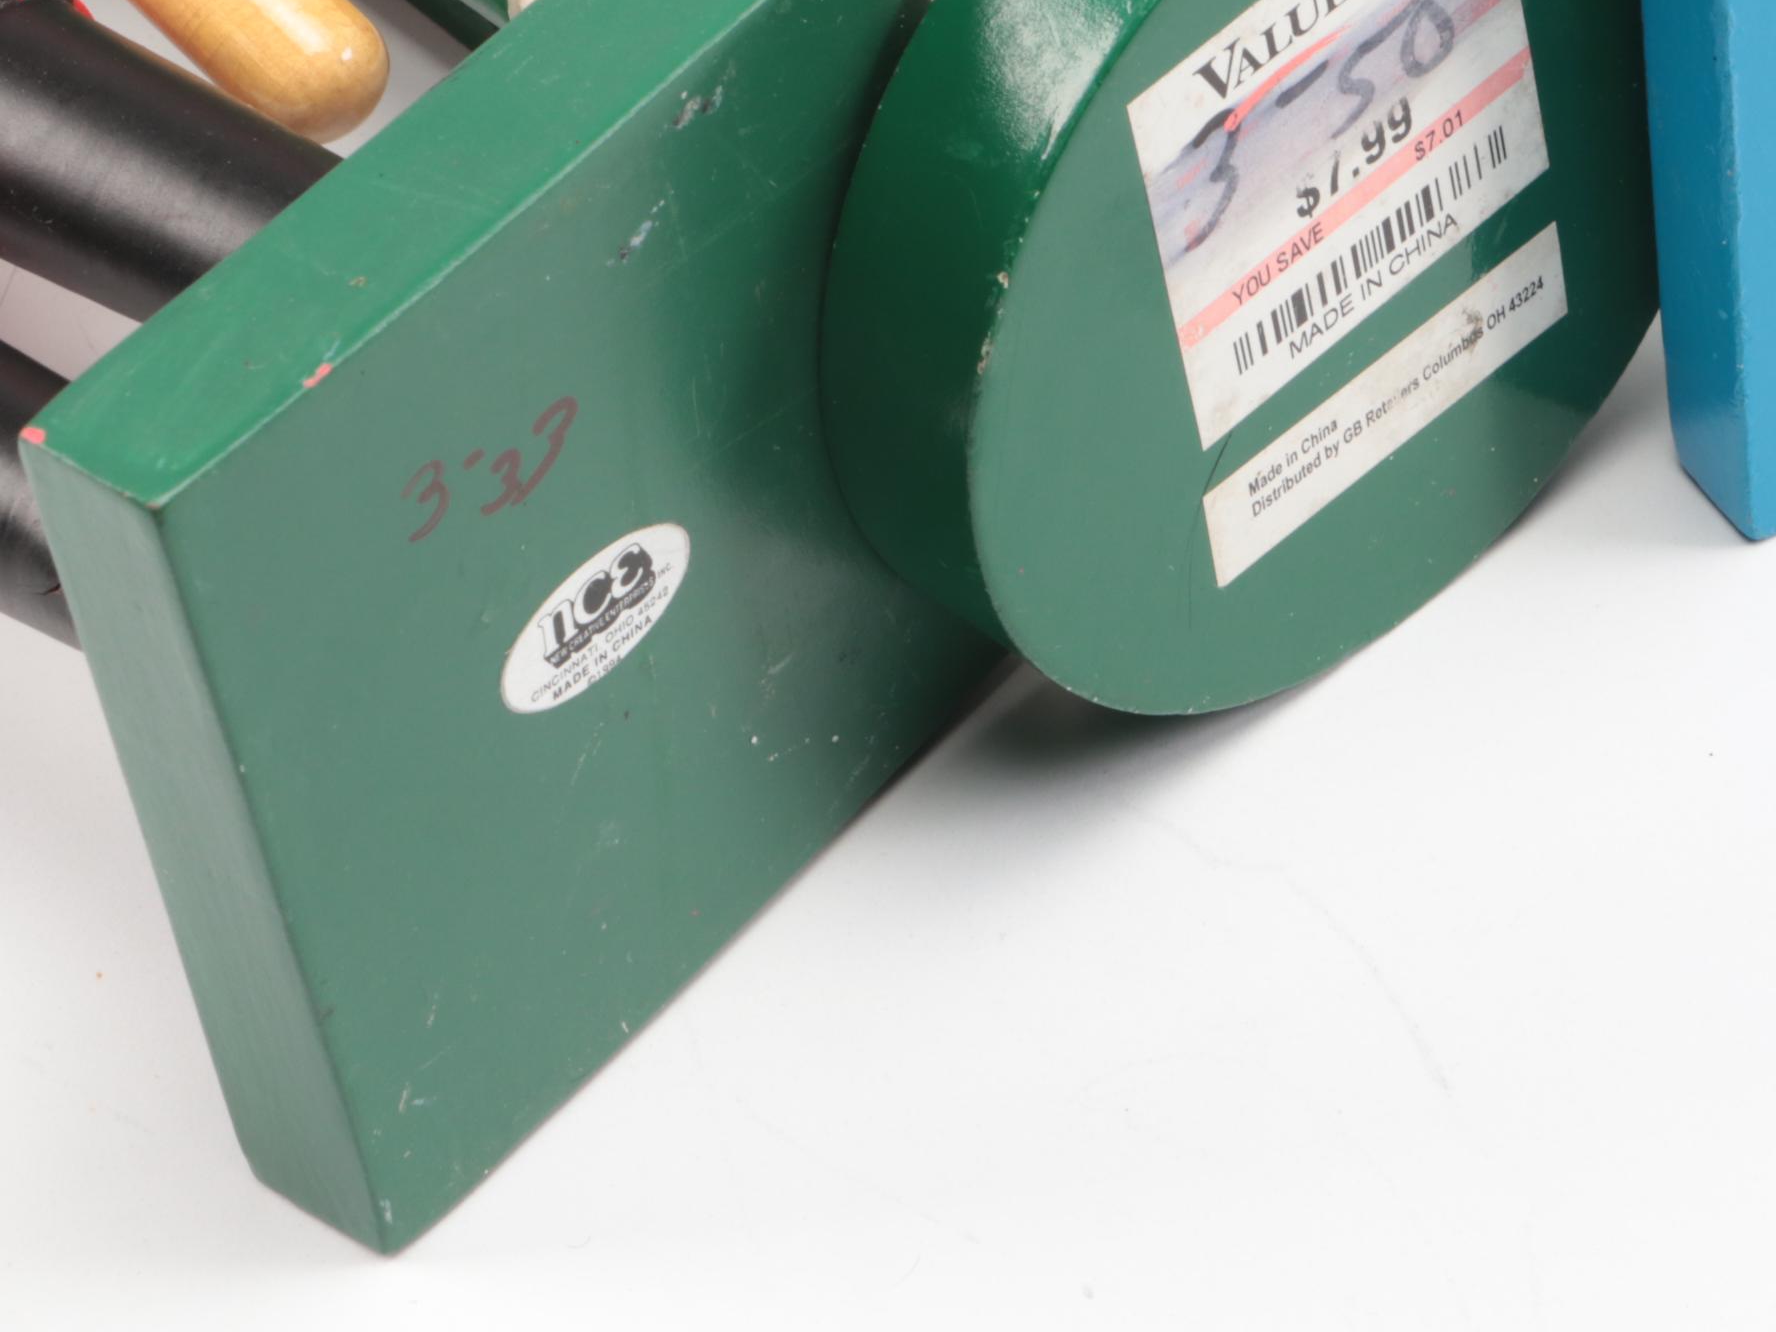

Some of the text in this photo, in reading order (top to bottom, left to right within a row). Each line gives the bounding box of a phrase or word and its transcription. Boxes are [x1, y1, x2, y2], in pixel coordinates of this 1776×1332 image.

[1296, 95, 1412, 218] $7.99
[1414, 109, 1466, 161] $7.01
[1231, 222, 1325, 306] YOU SAVE
[1288, 213, 1458, 359] MADE IN CHINA
[1251, 452, 1322, 517] Distributed
[1324, 440, 1340, 460] by
[1343, 420, 1363, 443] GB
[1422, 327, 1484, 380] Columbus
[1486, 305, 1506, 330] OH
[1509, 275, 1544, 311] 43224
[1248, 420, 1338, 497] Made in China
[604, 614, 634, 643] OHIO
[637, 585, 669, 616] 45242
[553, 615, 652, 700] MADE IN CHINA
